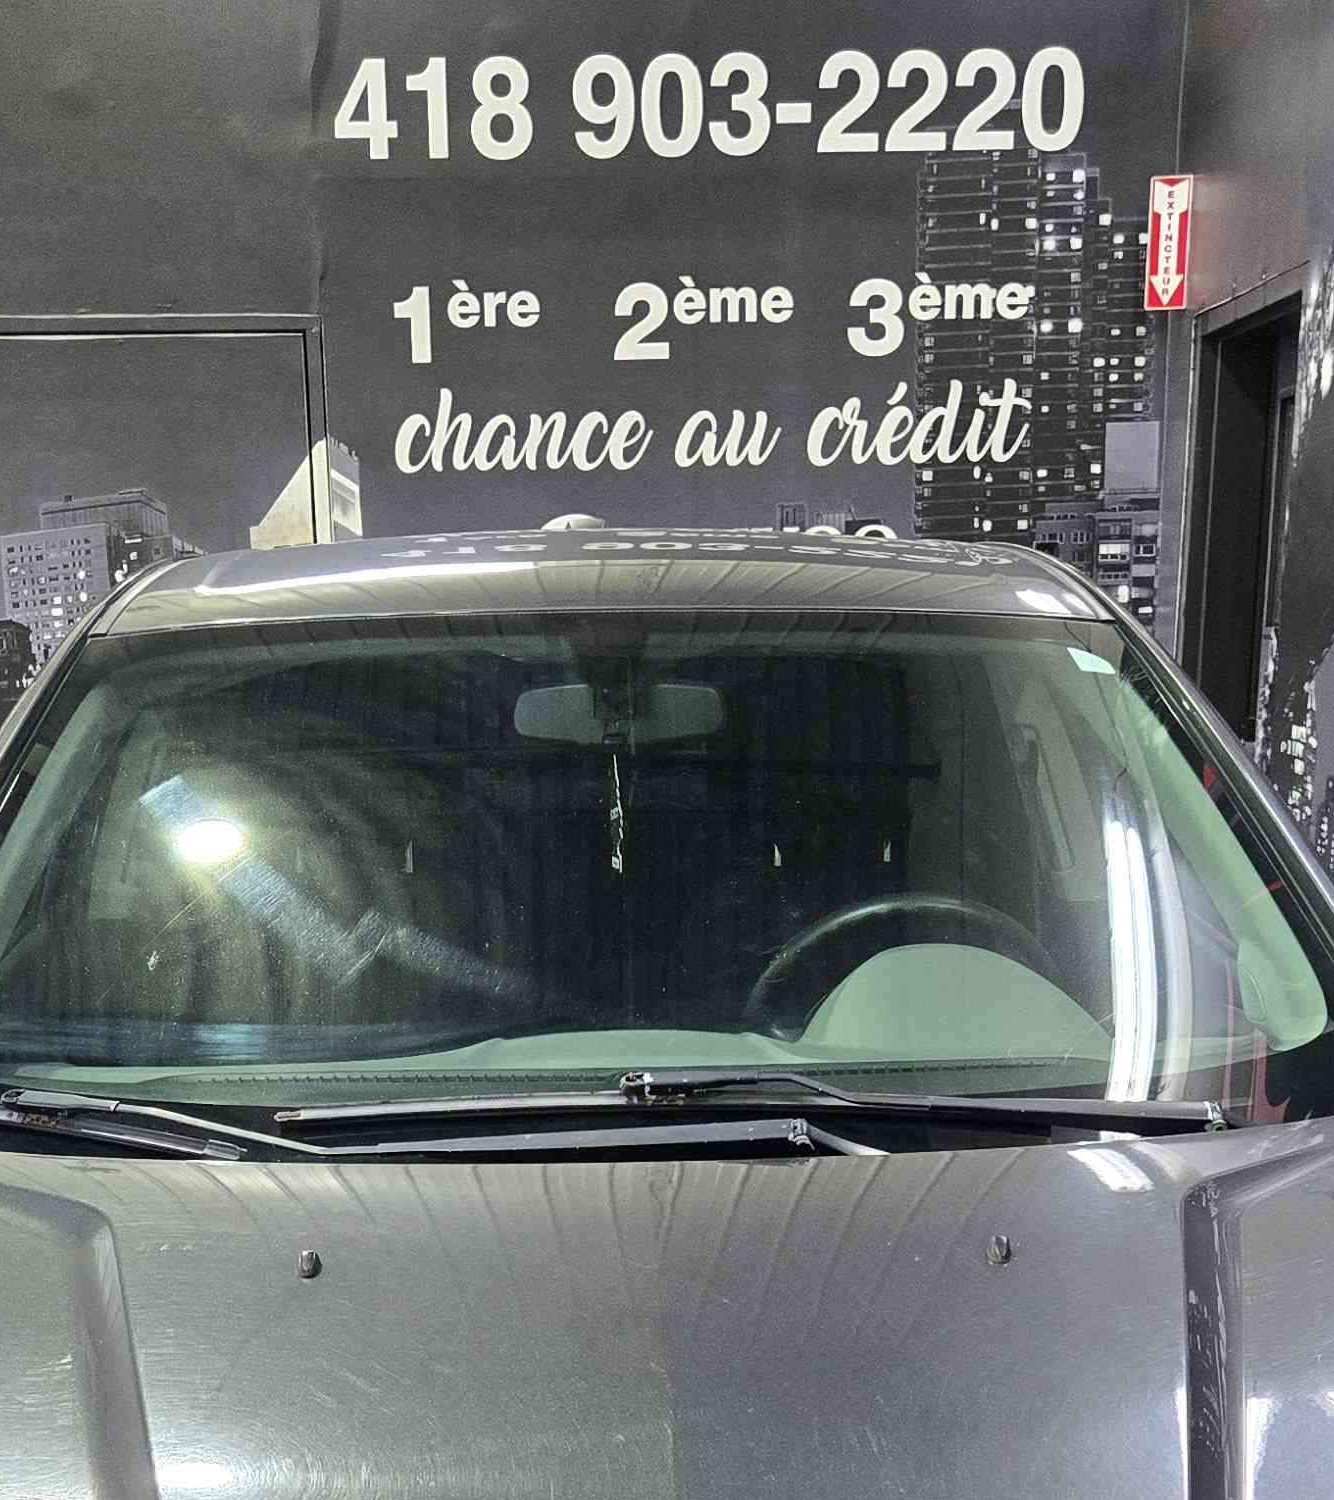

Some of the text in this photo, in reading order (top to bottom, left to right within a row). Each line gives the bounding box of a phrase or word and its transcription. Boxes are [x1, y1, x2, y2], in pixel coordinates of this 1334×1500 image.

[334, 46, 1084, 161] 418 903-2220
[1162, 190, 1176, 295] EXTINCTEUR
[393, 271, 1036, 364] 1ère 2ème 3ème
[394, 377, 1033, 474] chance au crédit
